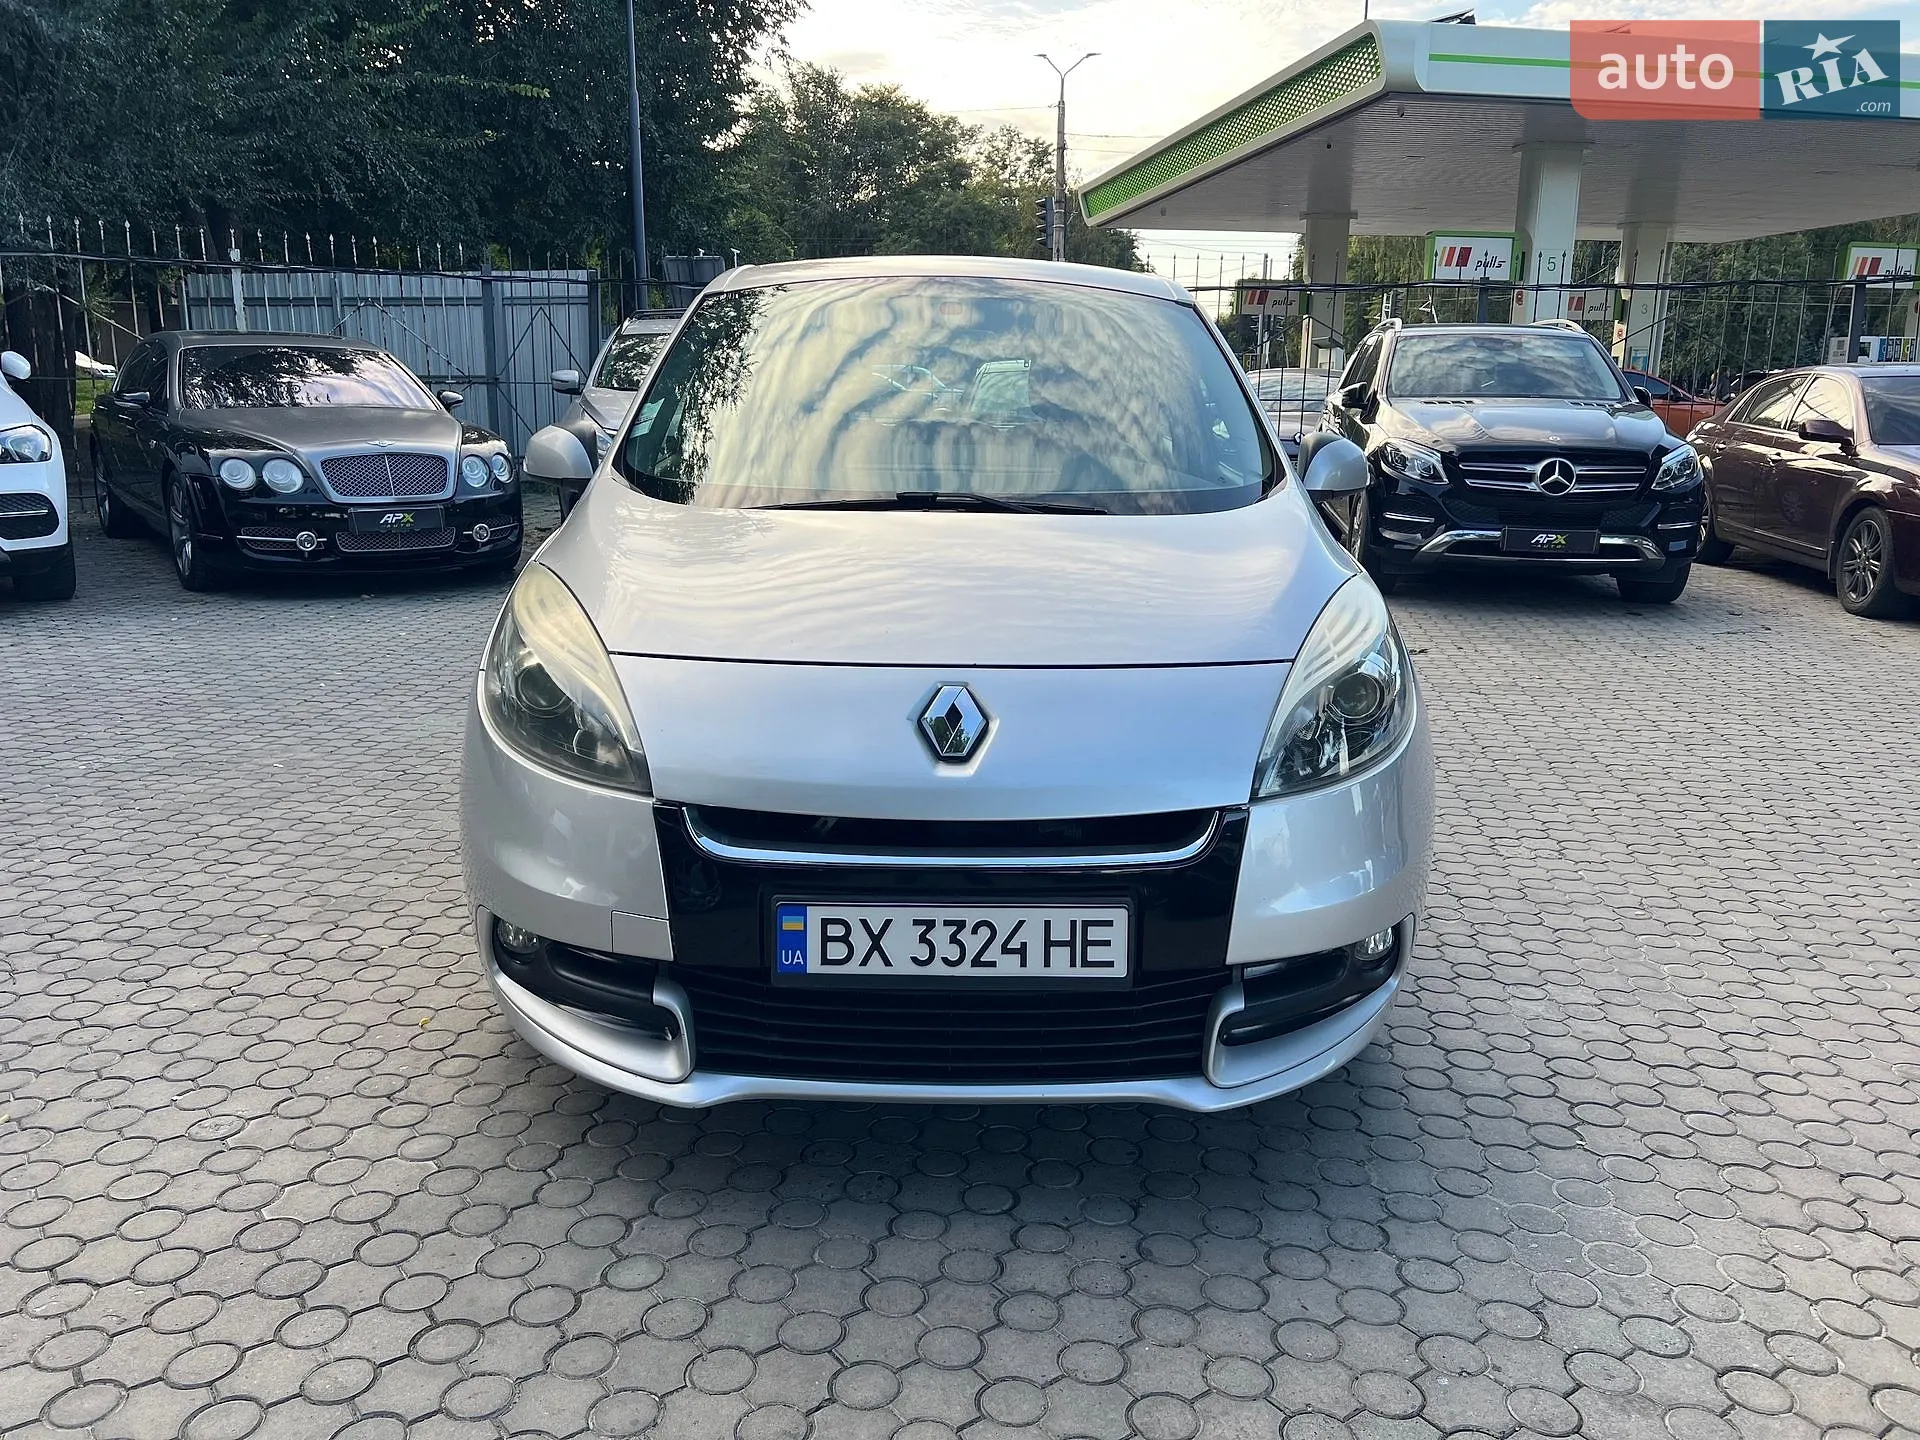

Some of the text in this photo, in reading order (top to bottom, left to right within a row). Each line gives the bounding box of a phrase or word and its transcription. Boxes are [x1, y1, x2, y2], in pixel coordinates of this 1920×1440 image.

[1547, 257, 1556, 272] 5
[820, 917, 1115, 968] BX 3324 HE
[782, 950, 804, 965] UA
